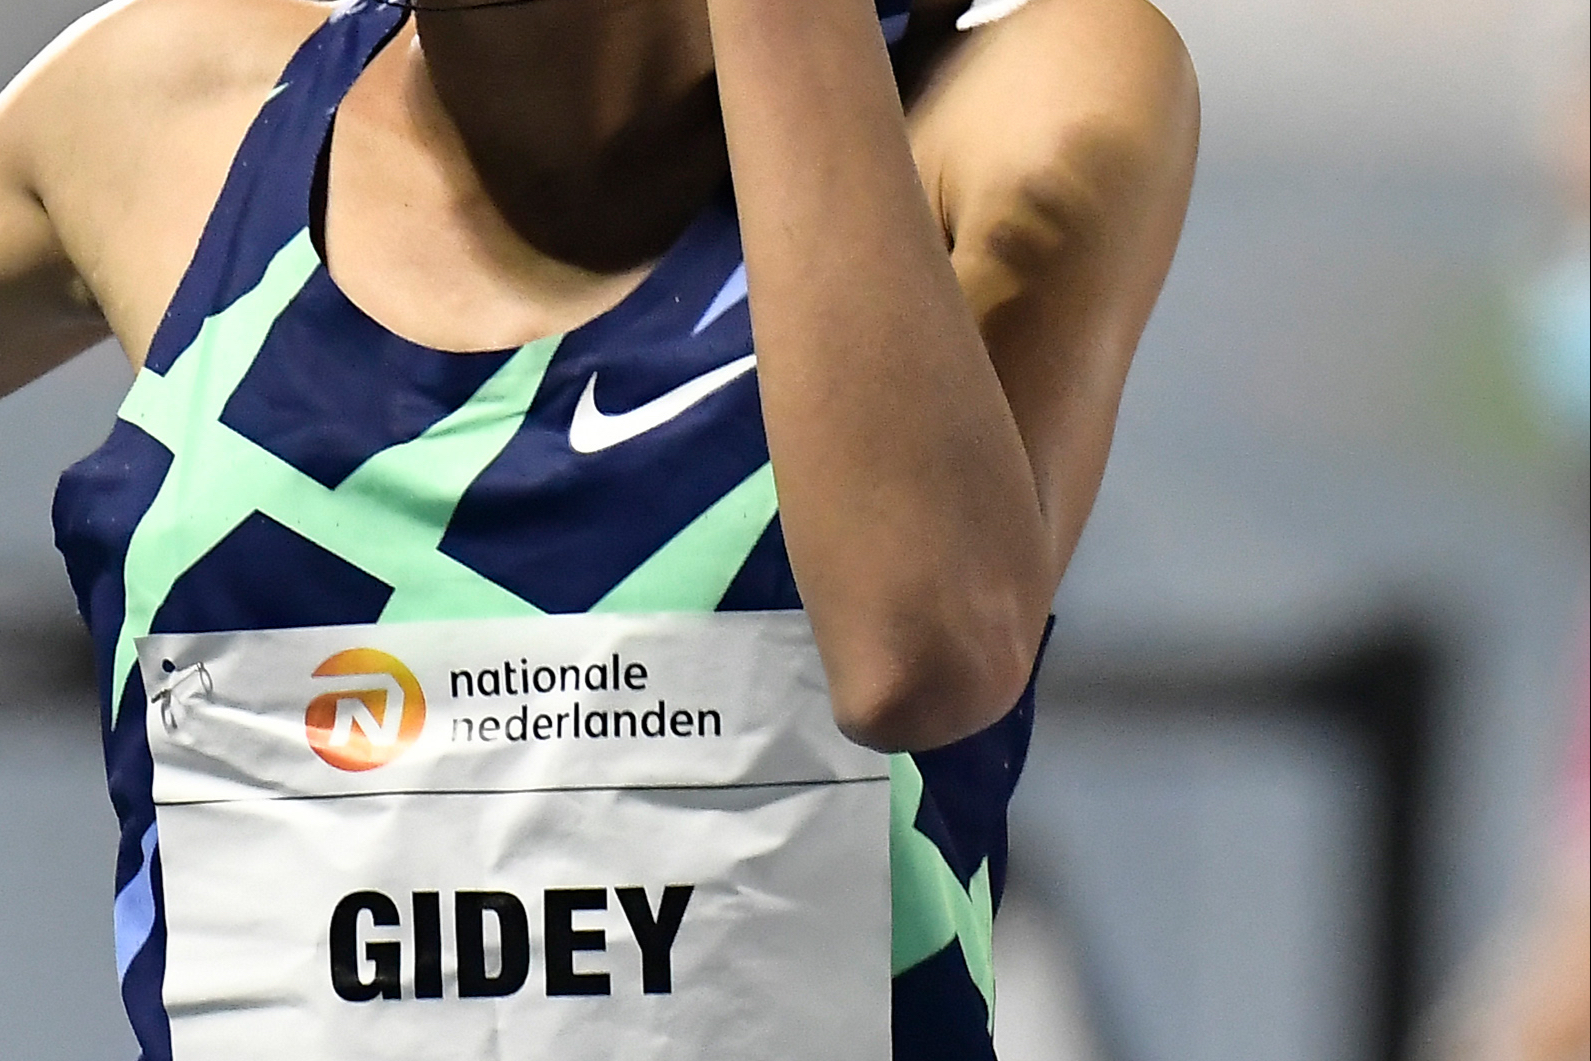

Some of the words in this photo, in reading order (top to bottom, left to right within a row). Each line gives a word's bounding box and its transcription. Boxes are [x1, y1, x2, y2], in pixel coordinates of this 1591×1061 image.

[449, 654, 648, 698] nationale
[451, 700, 722, 742] nederlanden
[329, 885, 695, 1002] GIDEY
